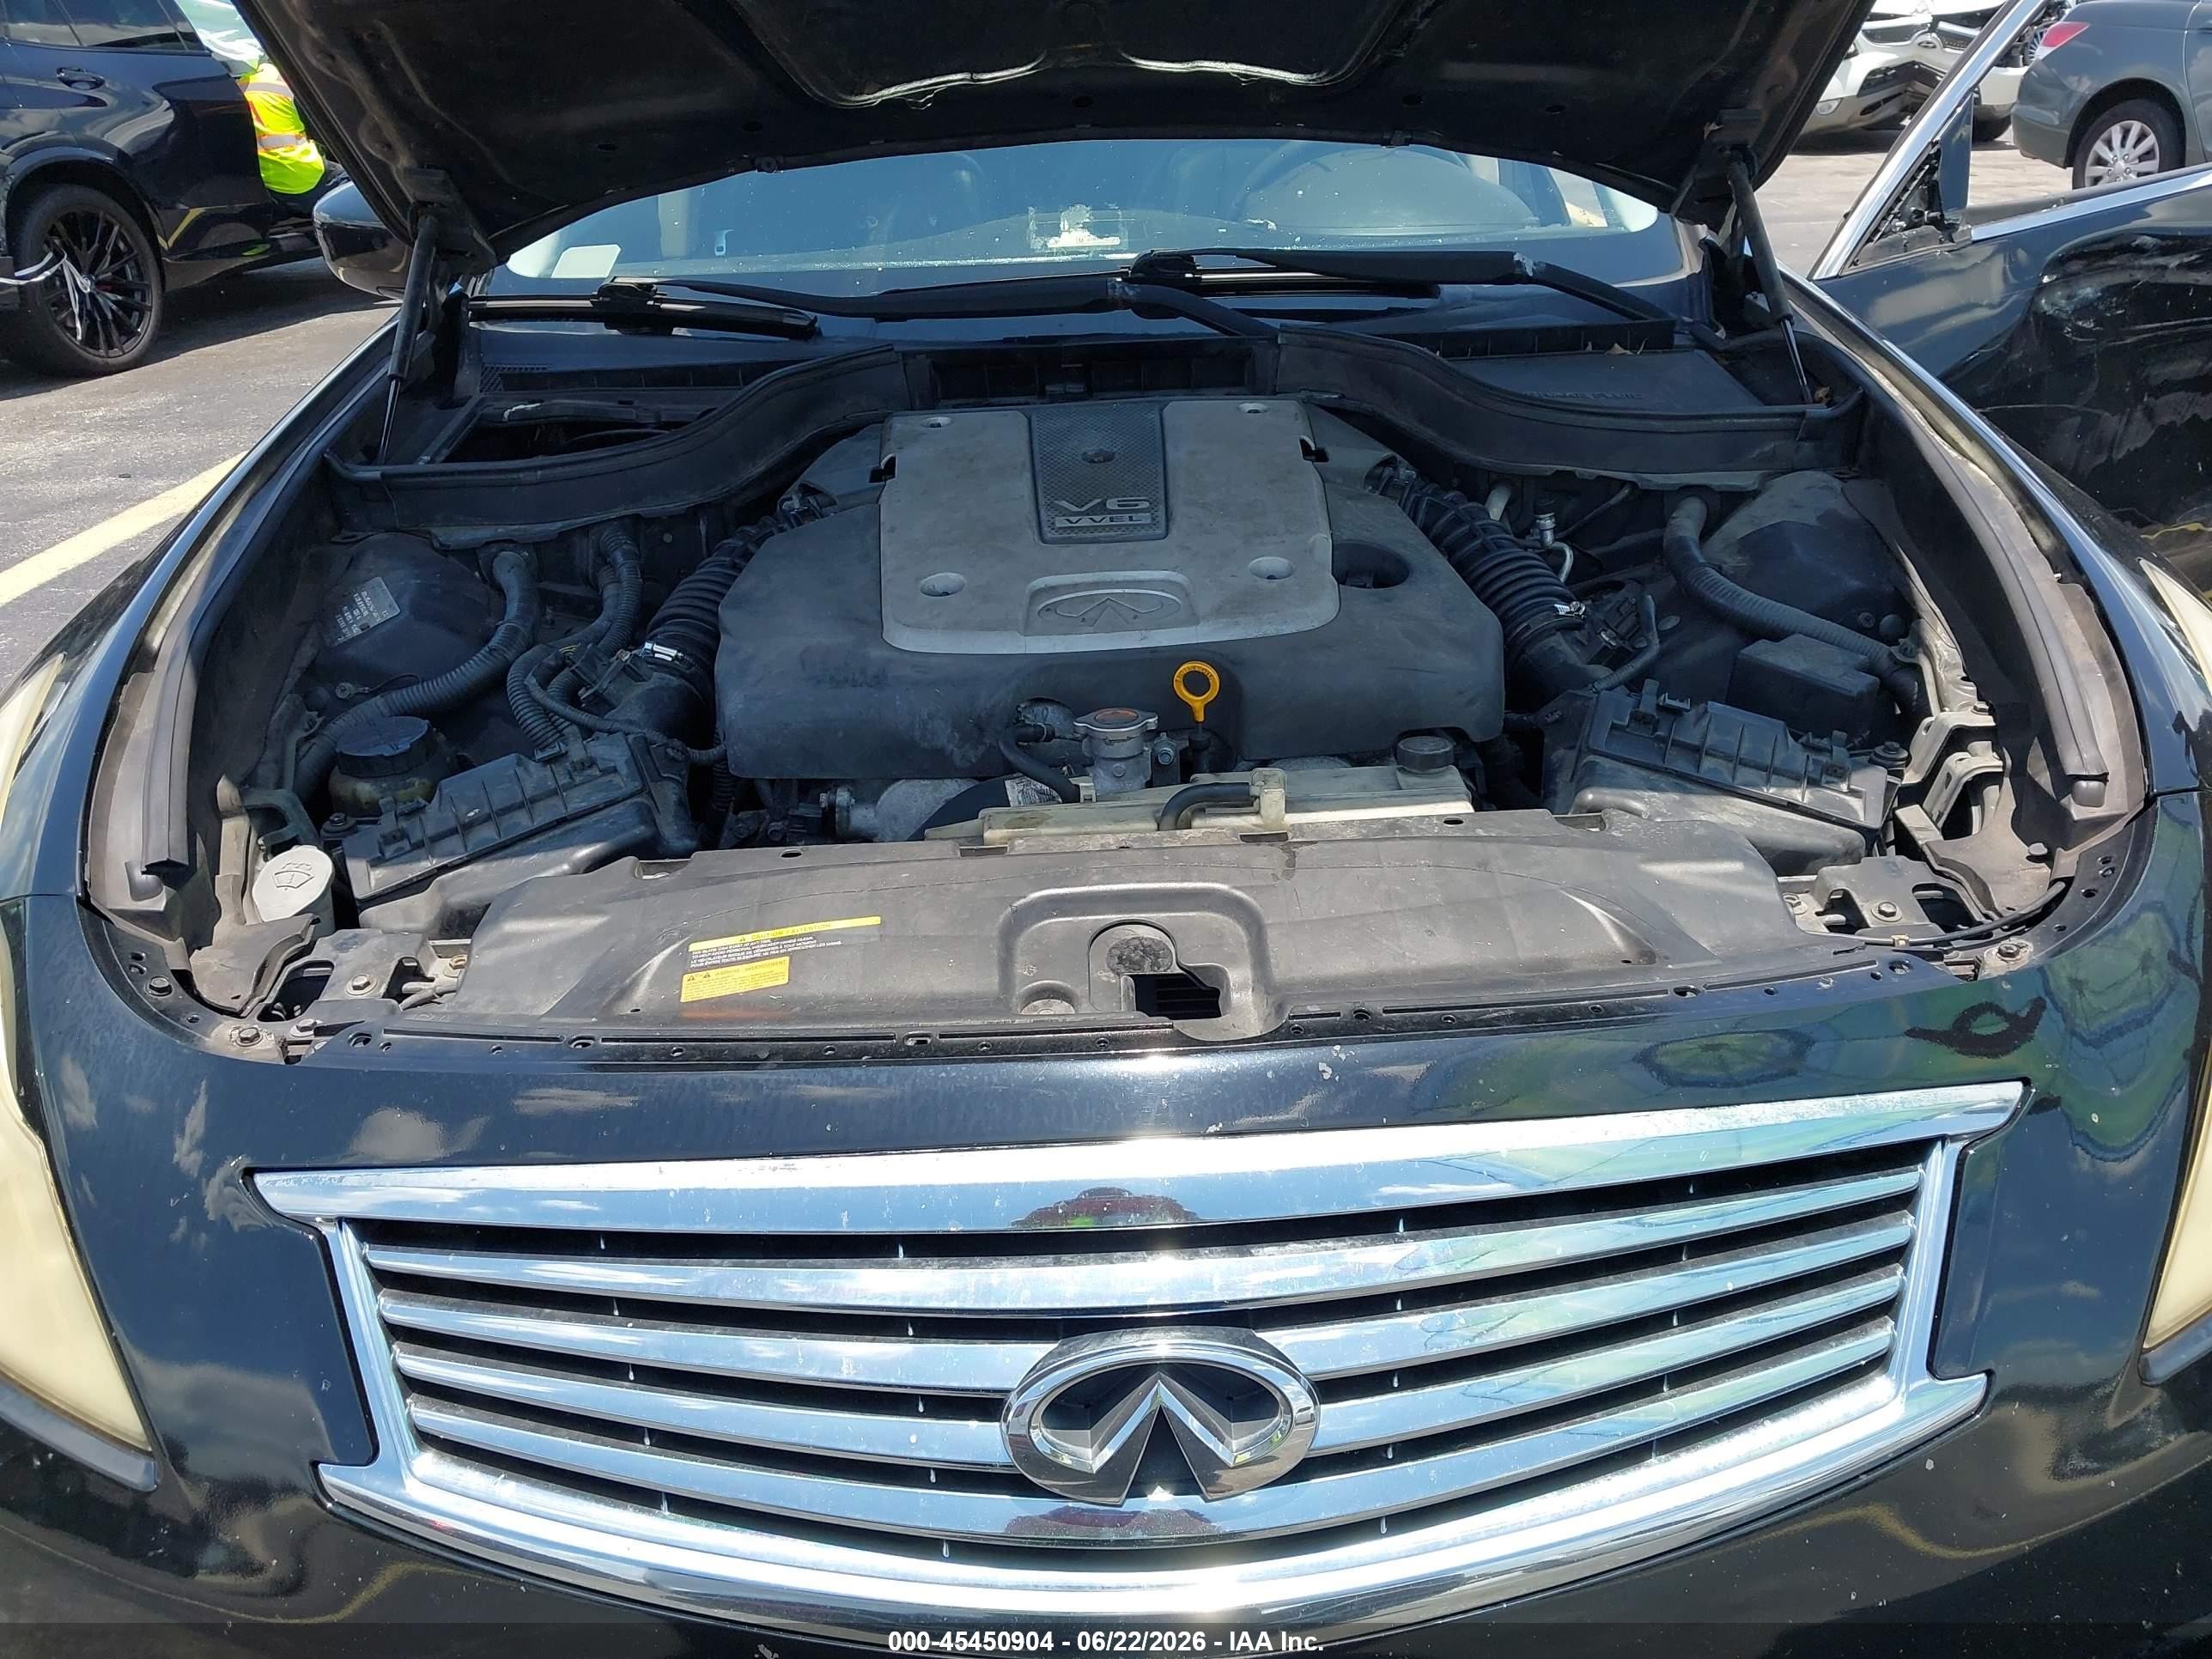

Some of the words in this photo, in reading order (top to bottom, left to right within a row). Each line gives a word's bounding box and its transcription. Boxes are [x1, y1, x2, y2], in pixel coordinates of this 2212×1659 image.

[1054, 496, 1150, 512] V6
[1064, 515, 1144, 525] VVEL
[792, 923, 831, 933] ATTENTION
